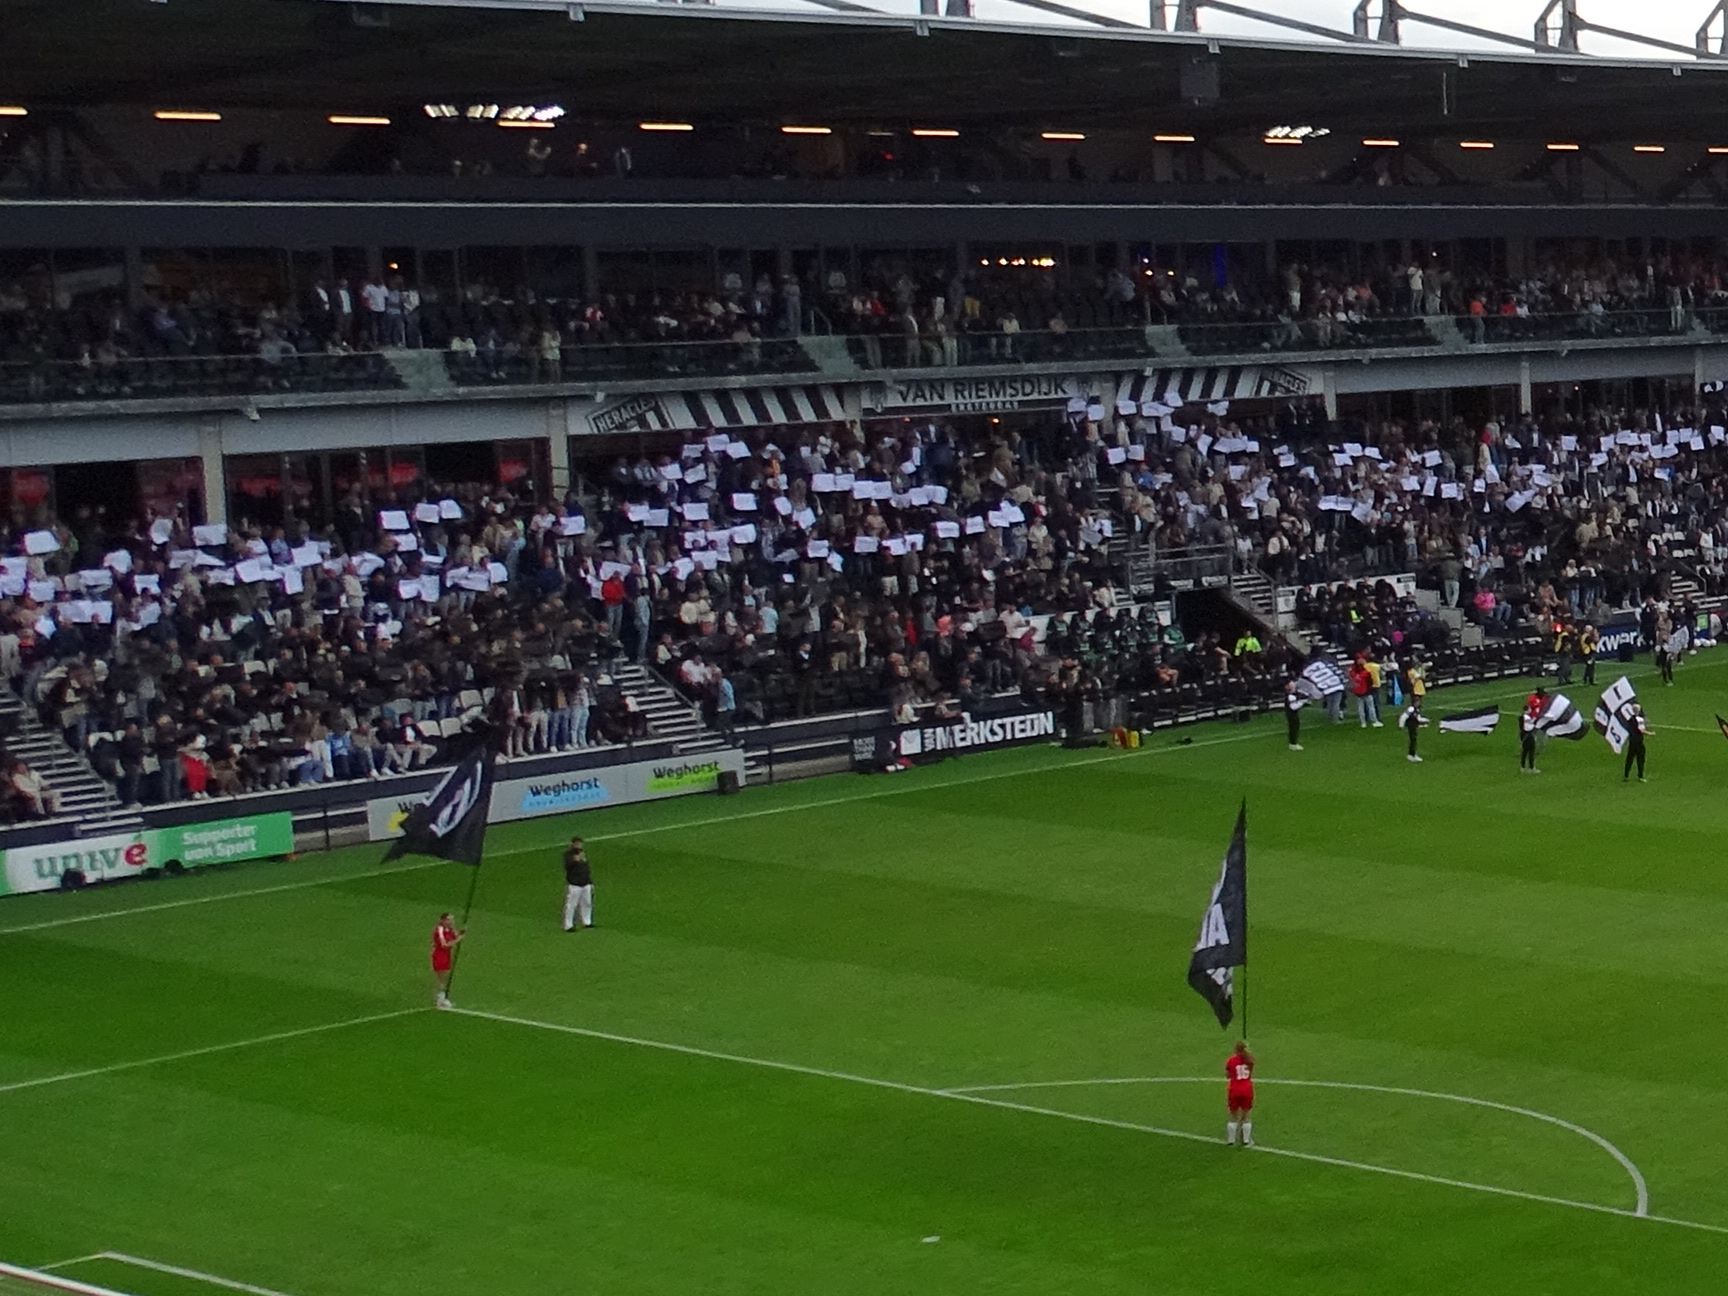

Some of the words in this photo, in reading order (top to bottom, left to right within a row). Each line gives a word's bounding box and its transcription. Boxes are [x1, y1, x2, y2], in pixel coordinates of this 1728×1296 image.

[899, 383, 945, 403] VAN
[954, 376, 1067, 400] RIEMSDIJK
[653, 759, 720, 781] Weghorst
[529, 776, 600, 798] Weghorst
